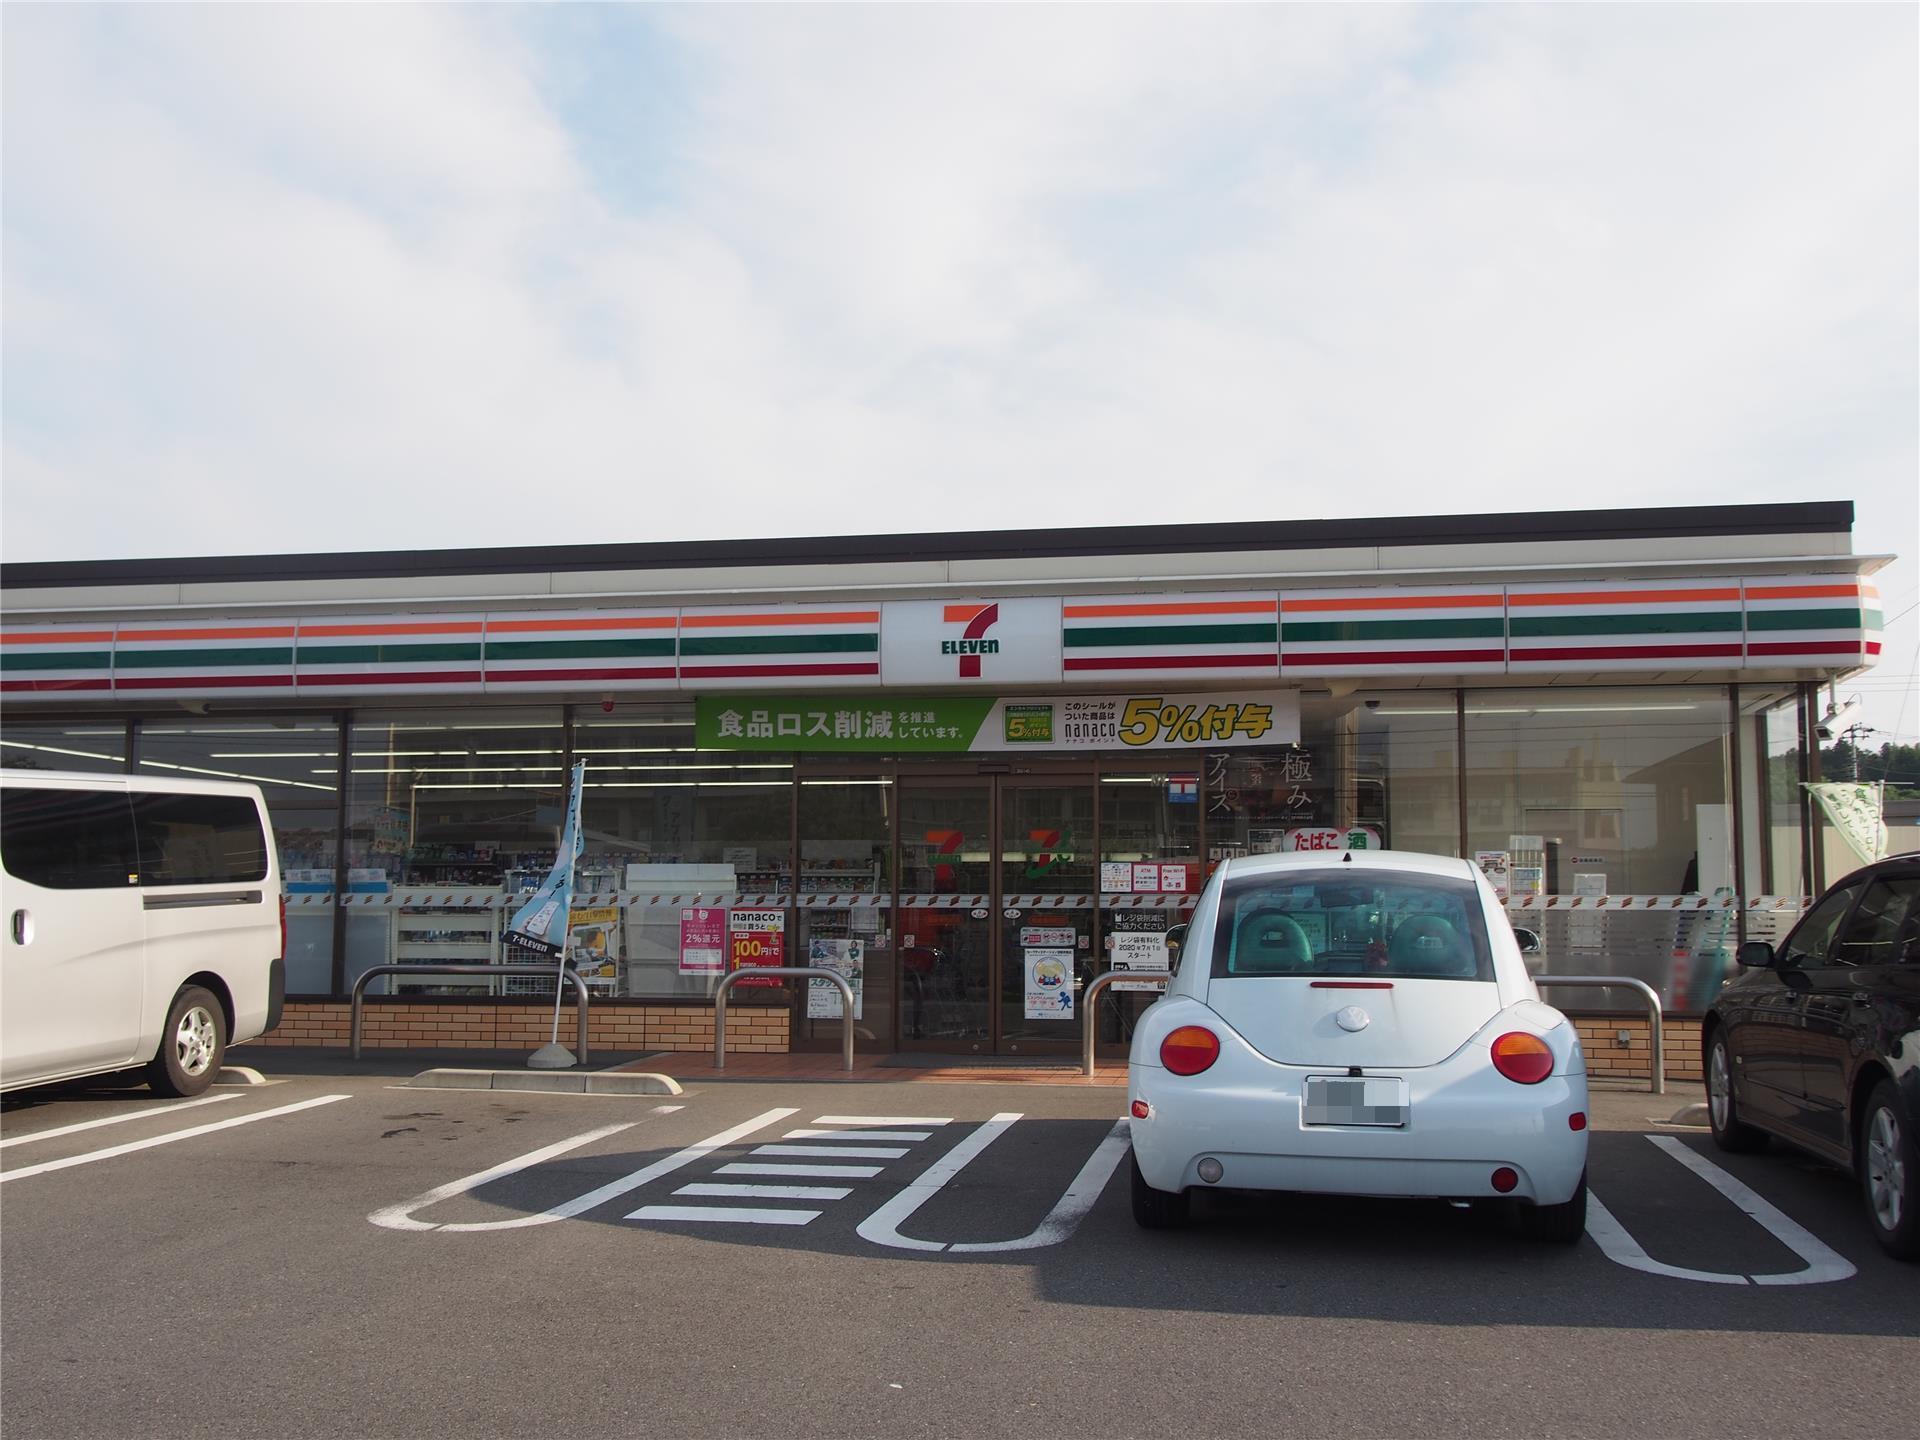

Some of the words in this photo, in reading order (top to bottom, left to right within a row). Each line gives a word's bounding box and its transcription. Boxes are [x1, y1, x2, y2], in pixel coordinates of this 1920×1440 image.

[944, 603, 998, 677] 7
[1065, 702, 1116, 711] このシールが
[717, 709, 894, 739] 食品ロス削減
[898, 711, 936, 724] を推進
[1064, 712, 1116, 721] ついた商品は
[1117, 697, 1274, 746] 5%付与
[898, 726, 964, 739] しています。
[1008, 718, 1050, 738] 5%付与
[1065, 723, 1116, 738] nanaco
[1209, 753, 1231, 813] アイス
[1280, 753, 1313, 809] 極み
[1295, 832, 1339, 850] たばこ
[1347, 832, 1368, 850] 酒
[1115, 922, 1166, 930] ご協力ください
